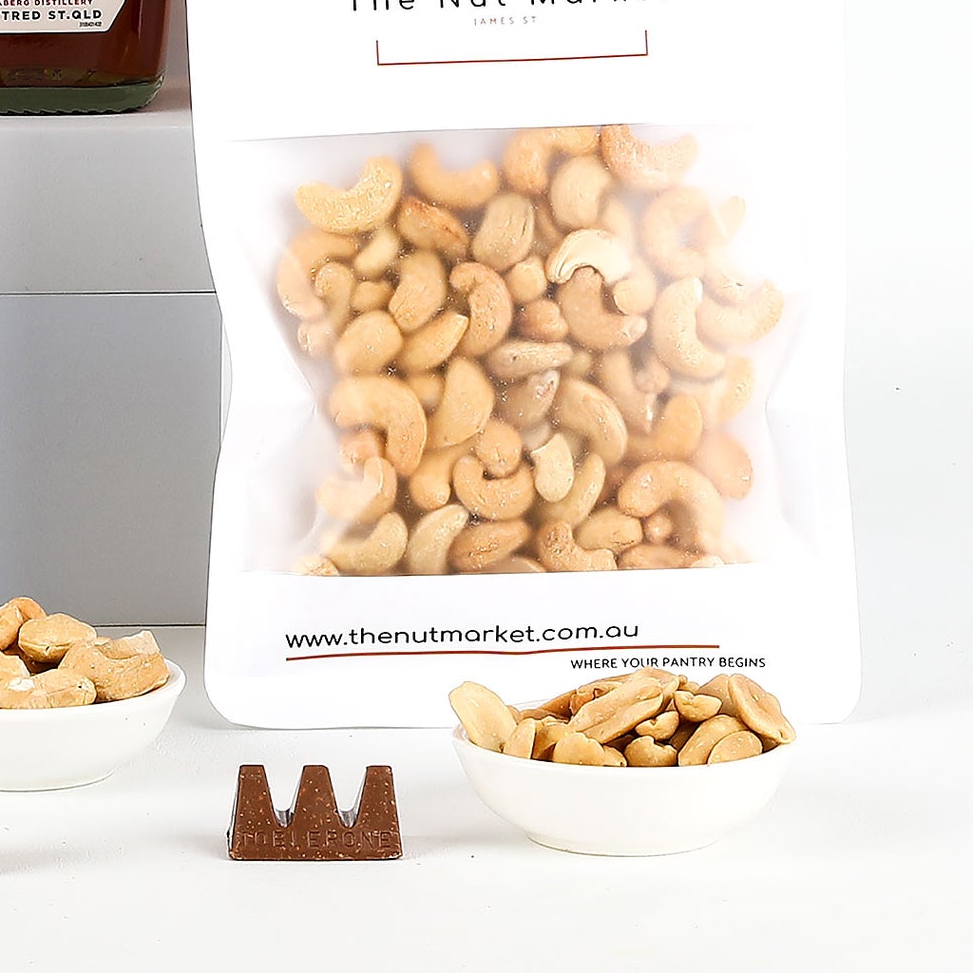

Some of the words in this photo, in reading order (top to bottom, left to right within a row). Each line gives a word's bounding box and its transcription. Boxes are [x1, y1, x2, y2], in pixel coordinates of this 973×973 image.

[473, 16, 515, 26] JAMES
[522, 15, 537, 25] ST
[285, 624, 640, 649] www.thenutmarket.com.au
[570, 658, 618, 669] WHERE
[621, 657, 659, 668] YOUR
[662, 657, 715, 667] PANTRY
[718, 657, 766, 668] BEGINS
